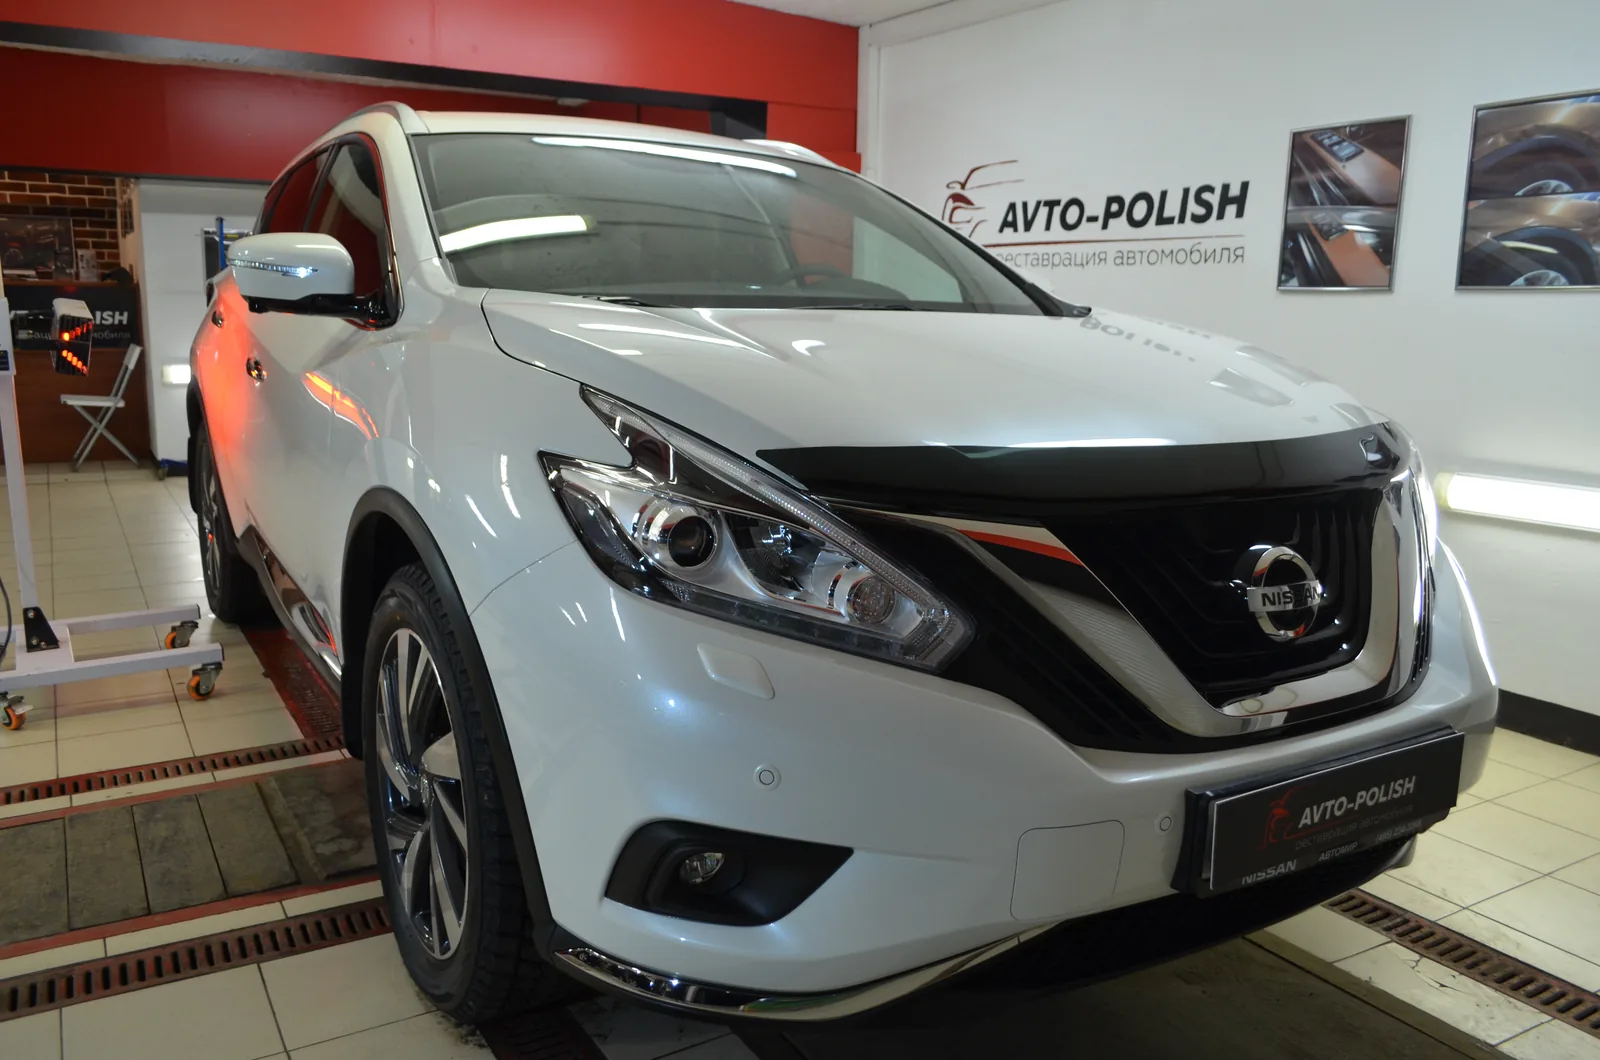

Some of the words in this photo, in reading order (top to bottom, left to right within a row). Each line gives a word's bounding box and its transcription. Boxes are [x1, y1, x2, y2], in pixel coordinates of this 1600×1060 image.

[998, 180, 1250, 233] AVTO-POLISH
[1113, 242, 1245, 267] автомобиля
[94, 310, 129, 325] ISH
[1297, 776, 1416, 829] AVTO-POLISH
[1318, 841, 1358, 862] АВТОМИР
[1241, 859, 1297, 885] NISSAN
